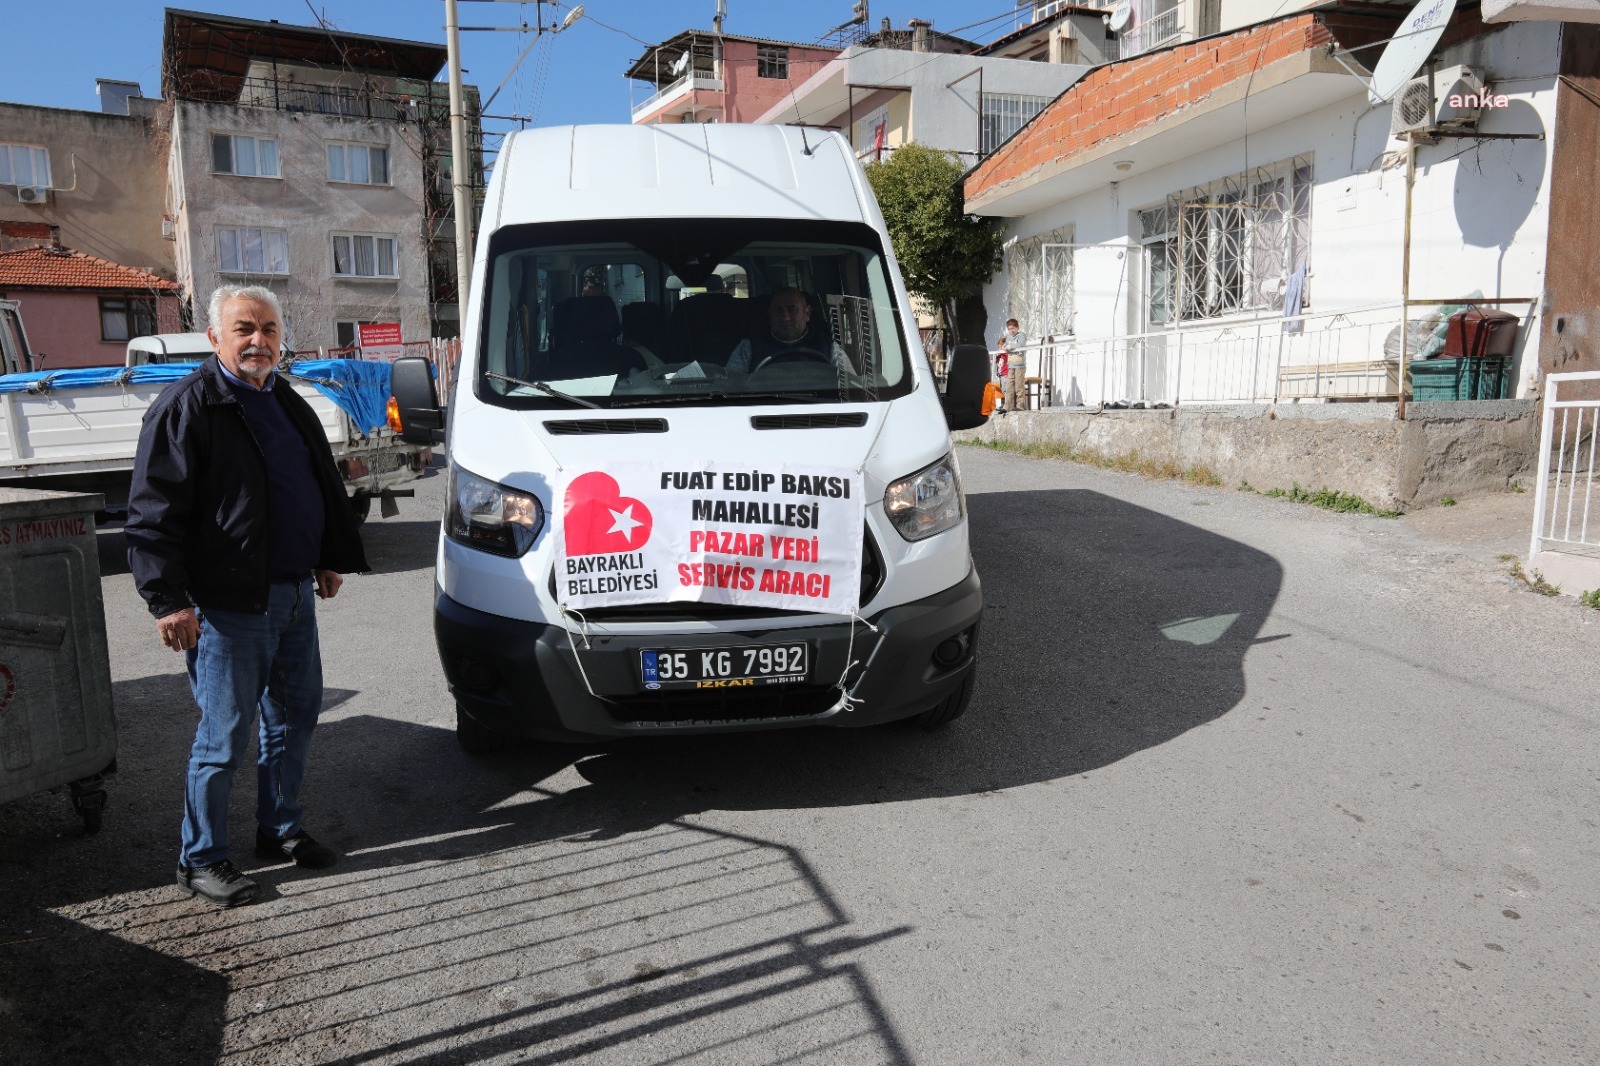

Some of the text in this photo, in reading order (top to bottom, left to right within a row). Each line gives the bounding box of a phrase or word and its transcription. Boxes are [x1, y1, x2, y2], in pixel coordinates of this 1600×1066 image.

[660, 470, 851, 499] FUAT EDİP BAKSI
[692, 499, 819, 530] MAHALLESİ
[15, 516, 87, 544] ATMAYINIZ
[689, 530, 819, 563] PAZAR YERİ
[566, 552, 644, 575] BAYRAKLI
[568, 568, 658, 596] BELEDİYESİ
[677, 561, 831, 599] SERVİS ARACI
[658, 646, 803, 679] 35 KG 7992
